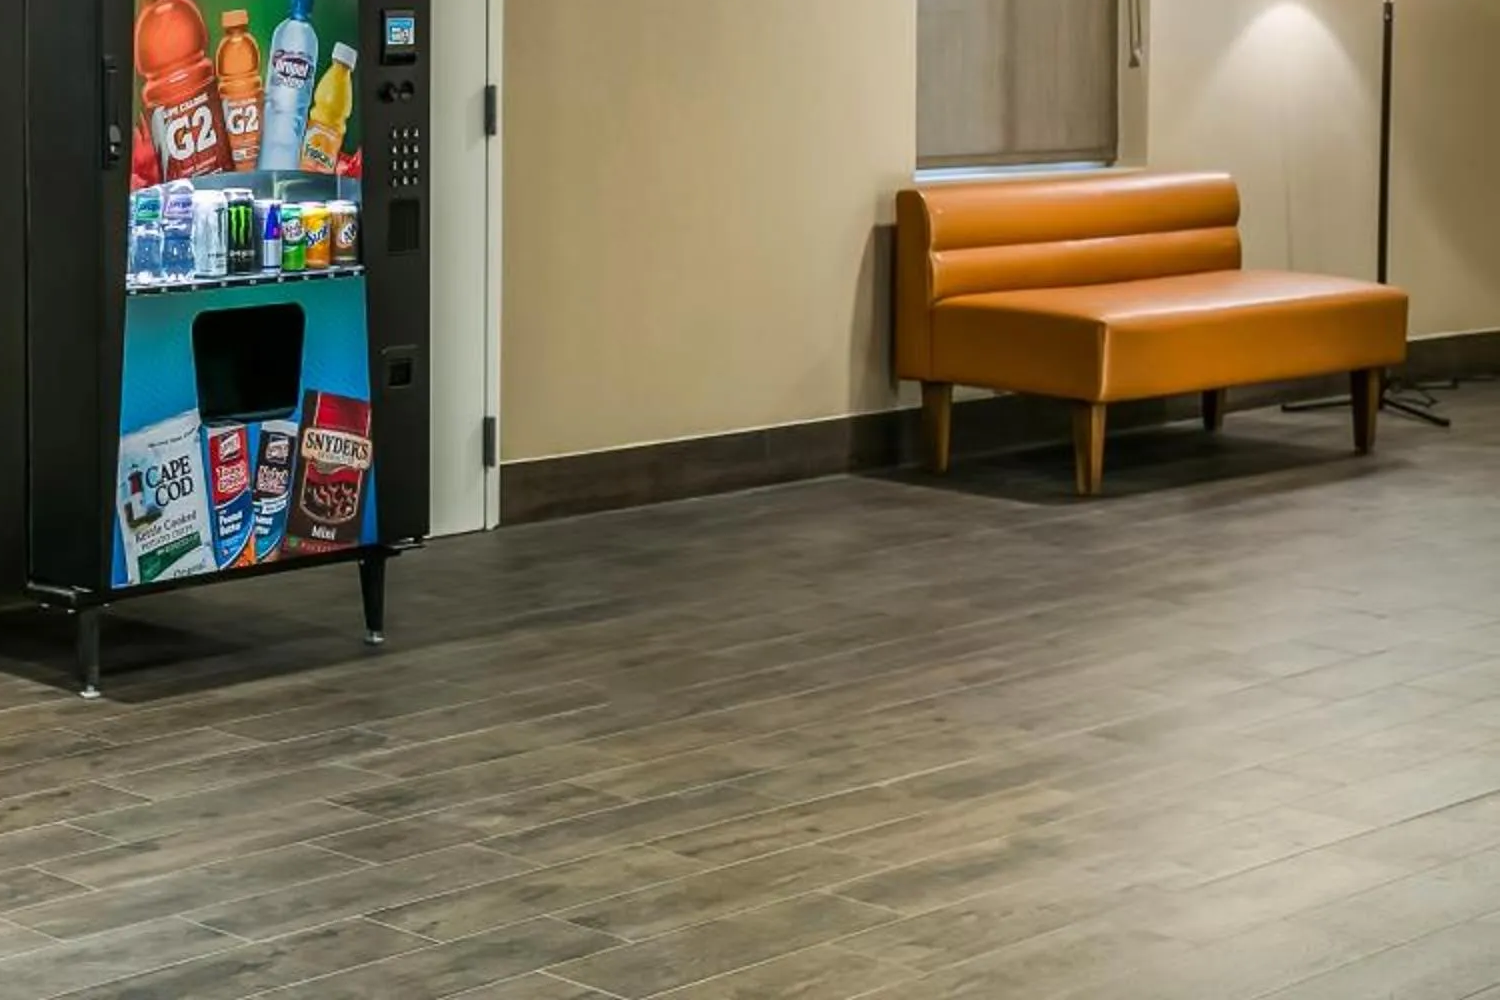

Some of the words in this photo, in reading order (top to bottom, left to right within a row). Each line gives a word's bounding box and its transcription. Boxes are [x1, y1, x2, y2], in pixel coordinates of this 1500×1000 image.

[167, 105, 217, 161] G2
[227, 105, 259, 135] G2
[306, 431, 369, 461] SNYDER'S
[145, 455, 192, 489] CAPE
[155, 475, 194, 508] COD
